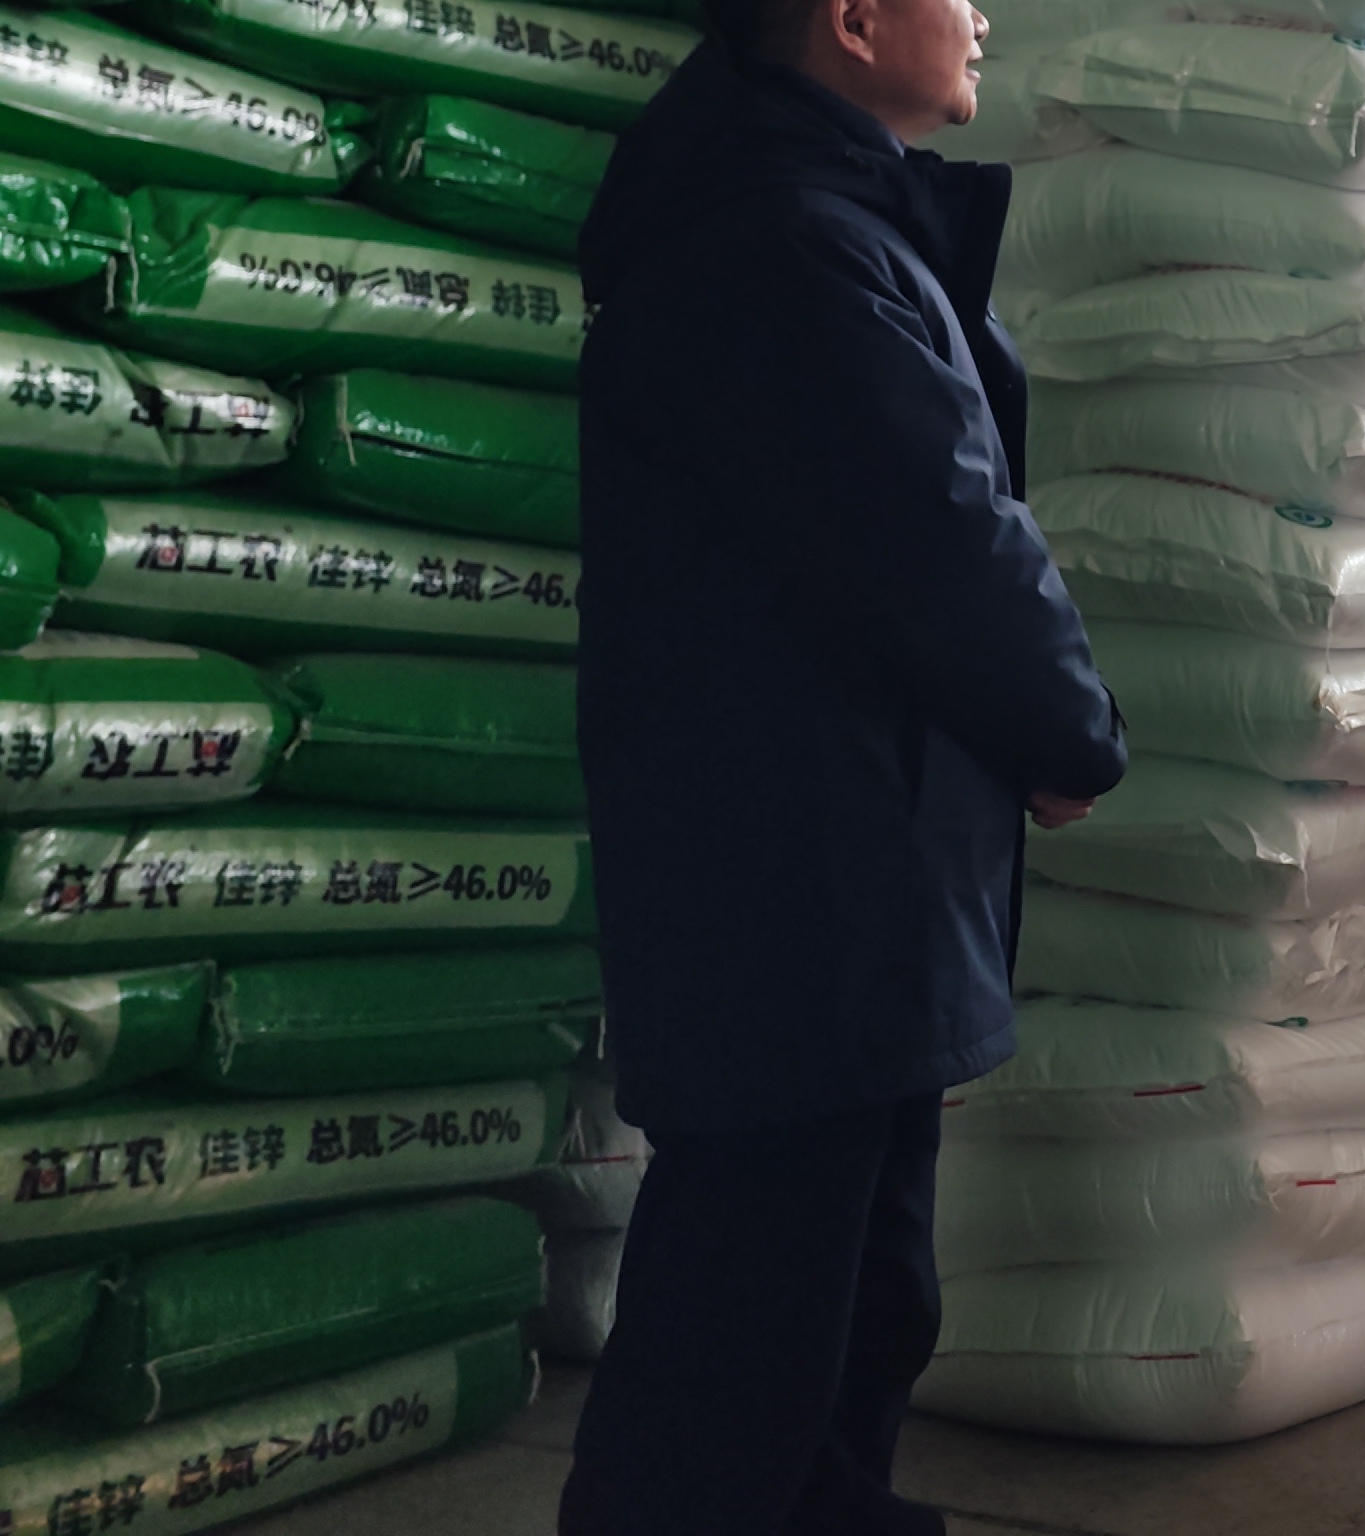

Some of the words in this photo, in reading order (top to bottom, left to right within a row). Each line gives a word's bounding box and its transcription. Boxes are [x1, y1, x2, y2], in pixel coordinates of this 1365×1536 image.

[410, 555, 579, 609] 总氮≥46.
[321, 860, 552, 905] 总氮≥46.0%
[306, 1106, 522, 1166] 总氮≥46.0%
